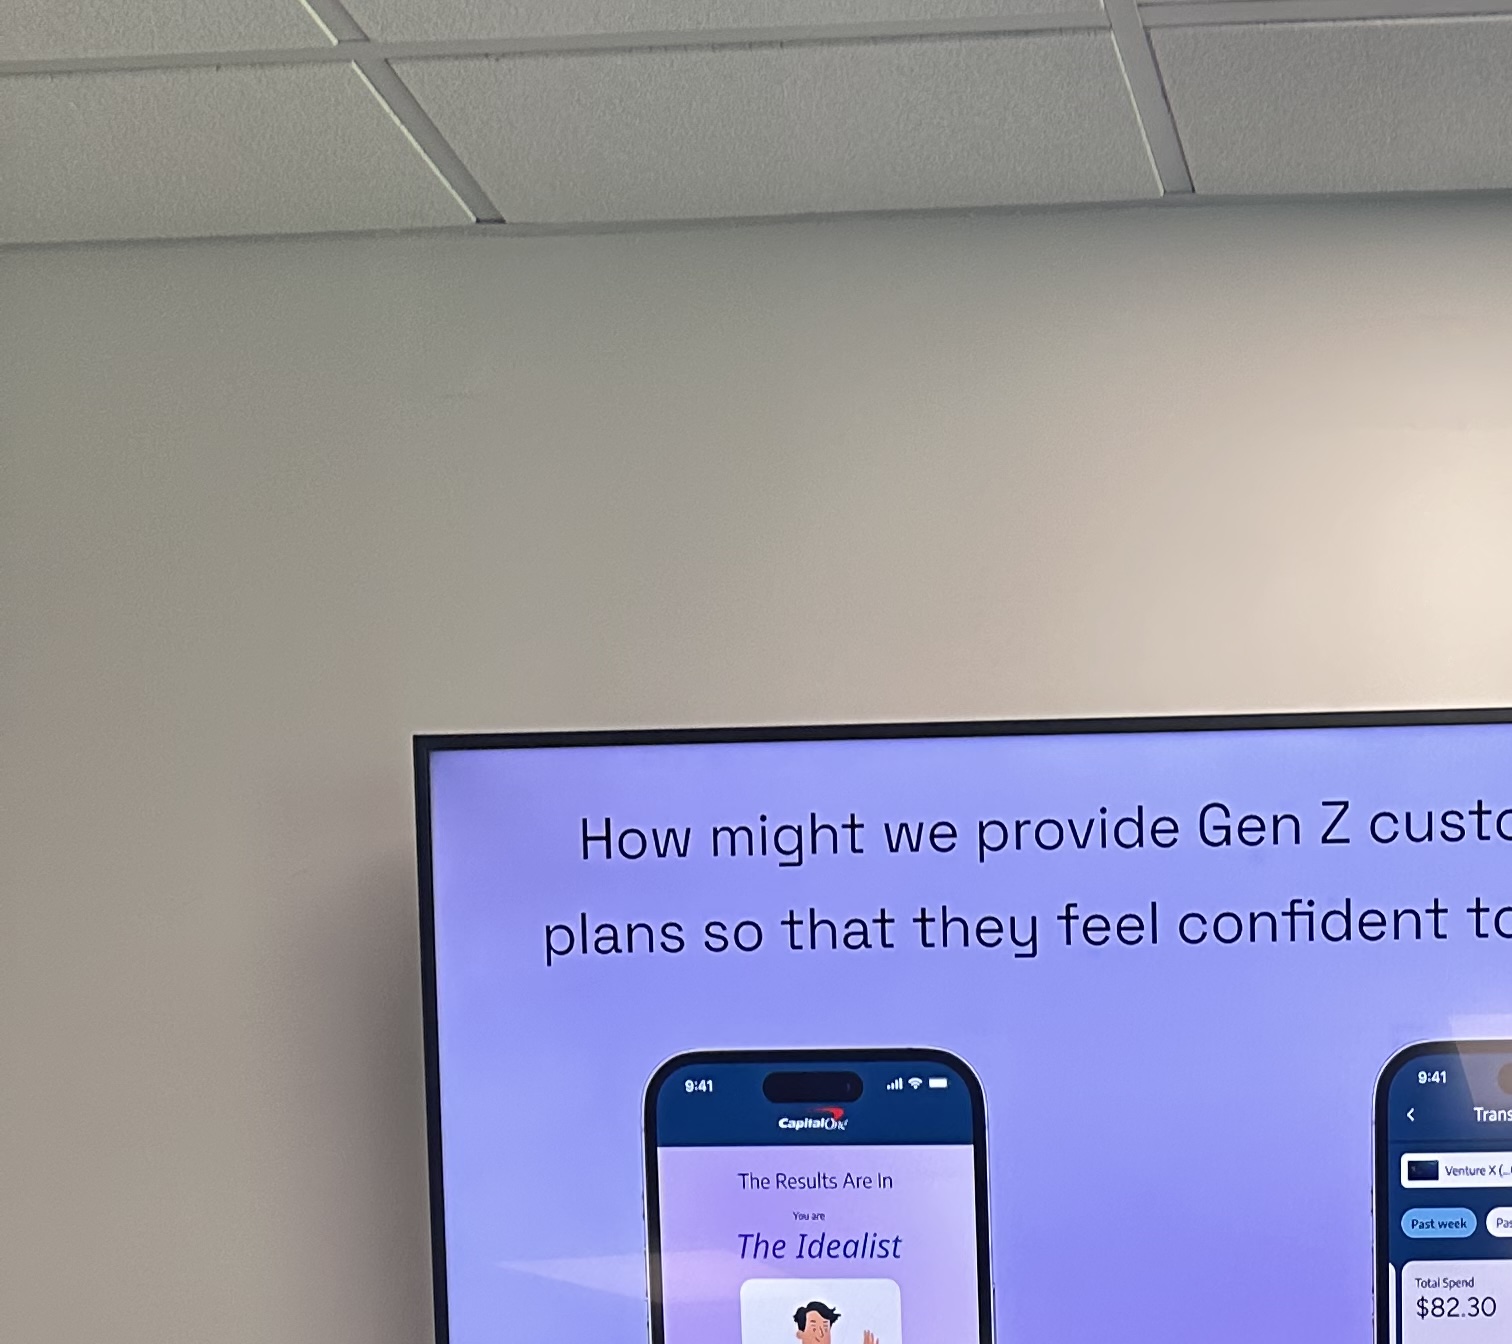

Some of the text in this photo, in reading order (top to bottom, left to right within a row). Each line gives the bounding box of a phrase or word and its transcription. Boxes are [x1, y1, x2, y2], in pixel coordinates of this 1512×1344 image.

[581, 816, 691, 860] How
[712, 811, 865, 868] might
[883, 820, 958, 853] we
[978, 804, 1179, 863] provide
[1198, 801, 1300, 848] Gen
[1320, 800, 1350, 844] Z
[544, 911, 685, 967] plans
[703, 919, 763, 953] so
[780, 907, 895, 950] that
[912, 904, 1038, 958] they
[1056, 900, 1158, 946] feel
[1178, 896, 1448, 945] confident
[1417, 1070, 1446, 1084] 9:41
[684, 1079, 712, 1092] 9:41
[1444, 1165, 1486, 1176] Venture
[1488, 1164, 1496, 1175] X
[737, 1171, 892, 1190] The Results Are In
[1411, 1217, 1467, 1229] Past week
[737, 1231, 902, 1259] The Idealist
[1414, 1276, 1474, 1290] Total Spend
[1416, 1295, 1496, 1320] $82.30
